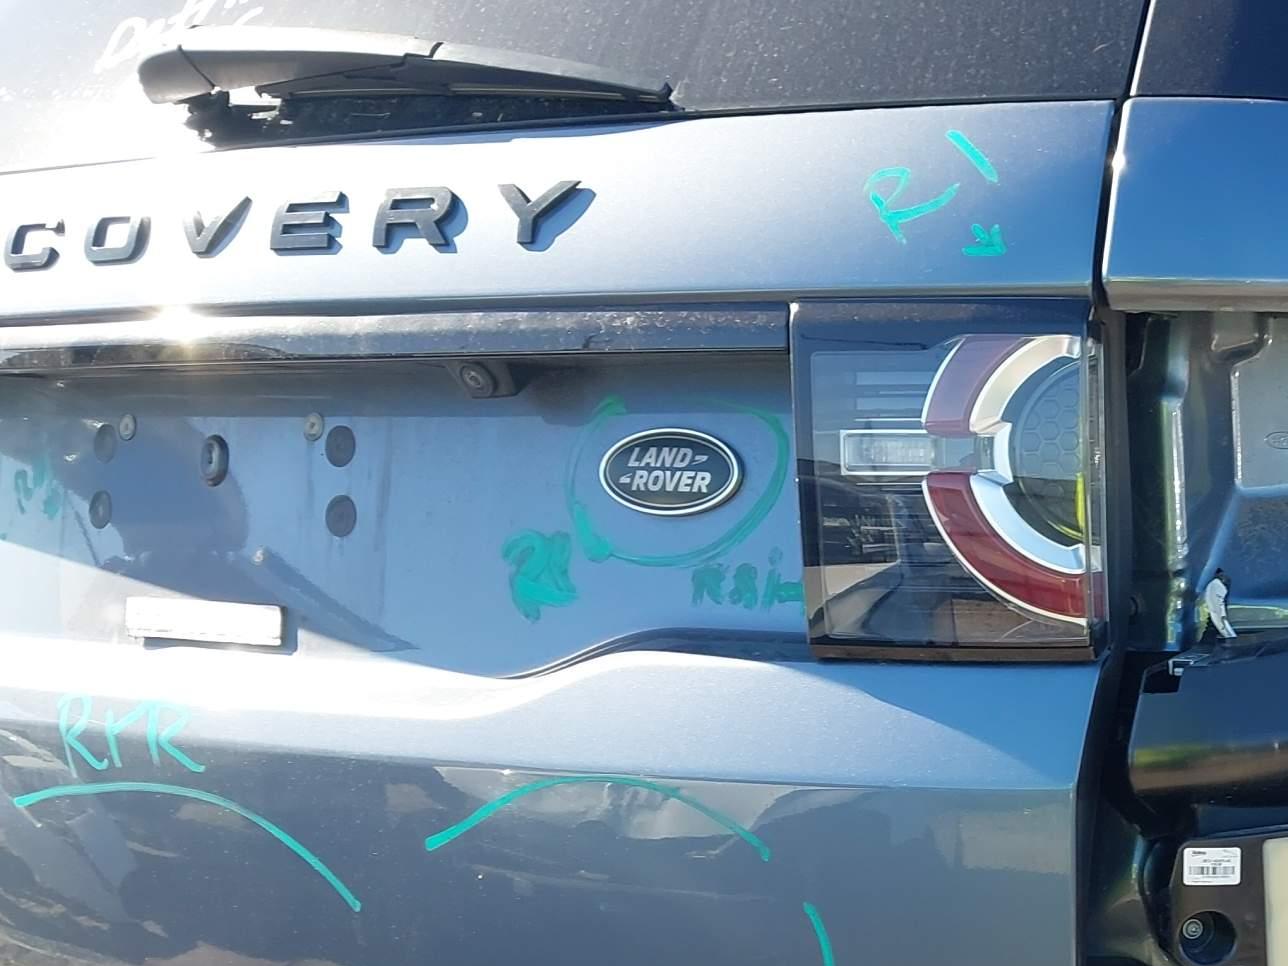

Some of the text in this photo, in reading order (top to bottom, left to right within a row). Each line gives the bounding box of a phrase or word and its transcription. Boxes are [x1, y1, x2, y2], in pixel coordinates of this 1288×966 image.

[4, 180, 596, 271] COVERY
[627, 447, 693, 468] LAND
[631, 470, 712, 493] ROVER
